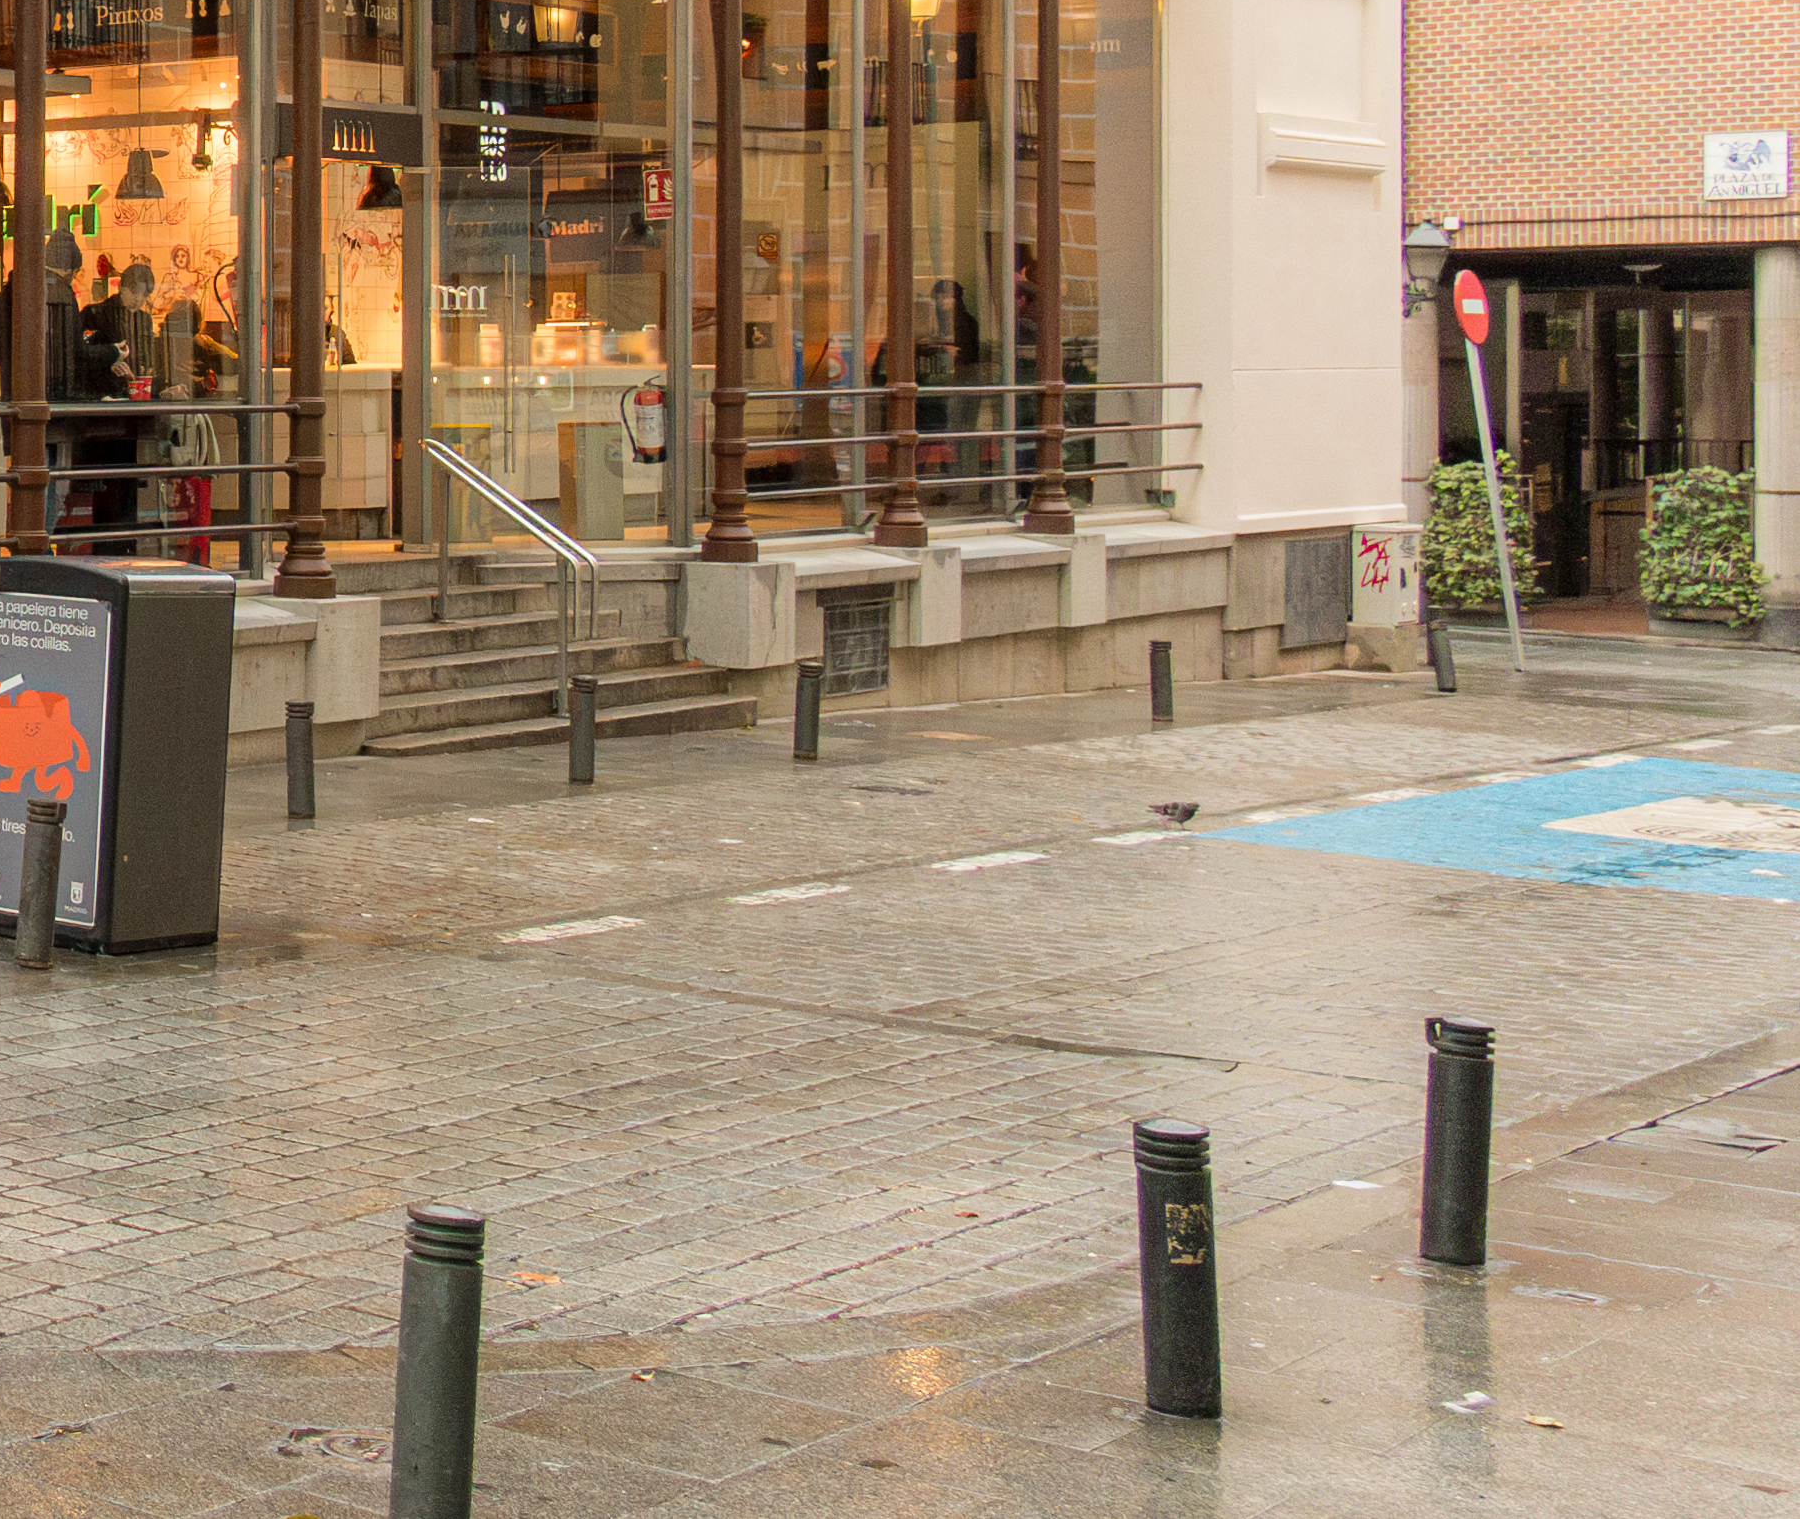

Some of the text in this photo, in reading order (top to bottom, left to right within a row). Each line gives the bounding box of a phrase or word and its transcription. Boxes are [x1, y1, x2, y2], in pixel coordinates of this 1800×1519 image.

[95, 4, 164, 27] Pintxos
[1713, 173, 1776, 184] PLAZA DE
[1731, 182, 1786, 196] MIGUEL
[6, 602, 57, 618] papelera
[58, 604, 89, 620] tiene
[44, 619, 96, 638] Deposita
[11, 632, 29, 648] las
[30, 635, 72, 652] colillas.
[1, 818, 26, 835] tires
